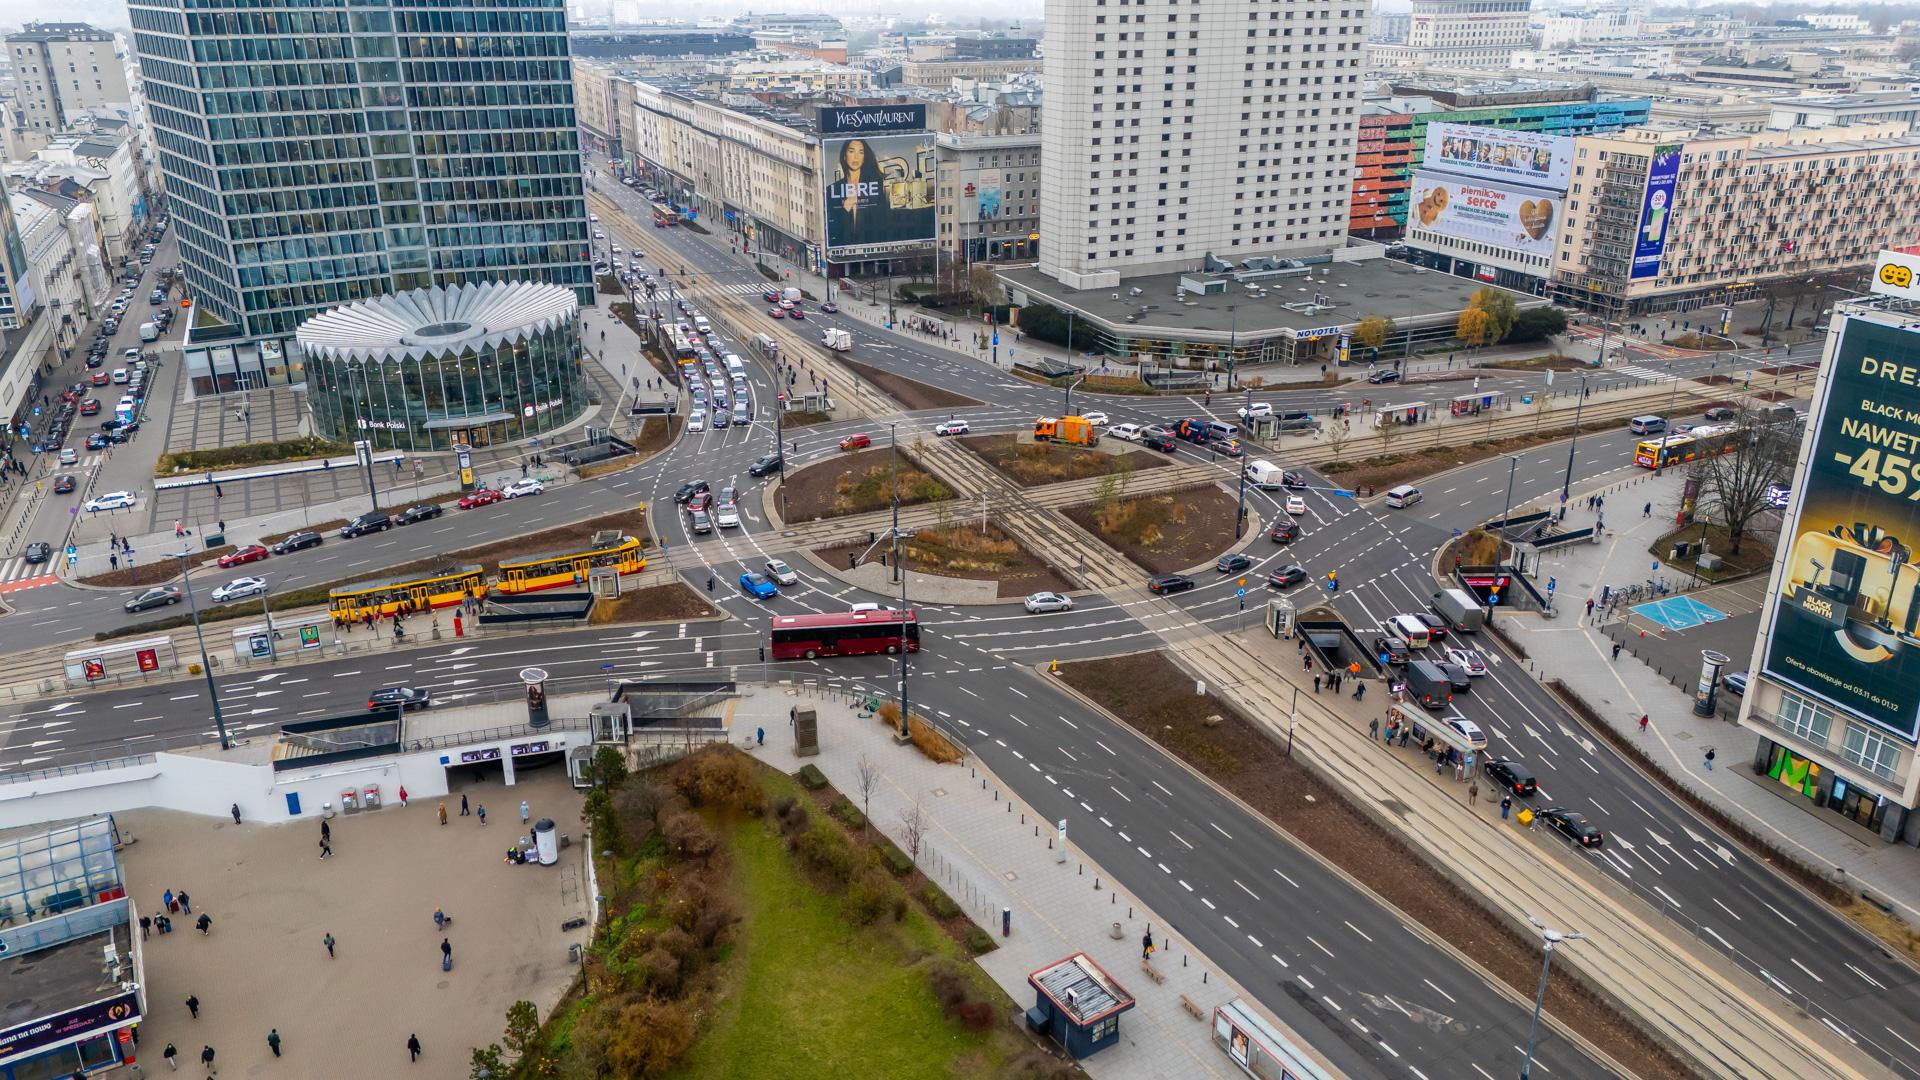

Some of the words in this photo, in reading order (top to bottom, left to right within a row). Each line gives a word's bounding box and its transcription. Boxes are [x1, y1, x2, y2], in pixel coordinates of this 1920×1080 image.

[830, 181, 879, 199] LIBRE
[1467, 195, 1497, 210] serce
[1296, 327, 1339, 338] NOVOTEL
[1860, 356, 1920, 387] DRE
[1861, 399, 1904, 421] BLACK
[369, 420, 385, 429] Bank
[386, 421, 406, 429] Polski
[1840, 417, 1920, 455] NAWET
[1802, 600, 1833, 619] MONTH
[1807, 595, 1833, 611] BLACK
[1785, 656, 1806, 671] Oferta
[1806, 666, 1842, 687] obowiązuje
[1843, 680, 1853, 691] od
[1853, 686, 1870, 699] 03.11
[1871, 694, 1880, 704] do
[1881, 699, 1899, 712] 01.12
[17, 1030, 29, 1039] na
[29, 1023, 52, 1035] nowo
